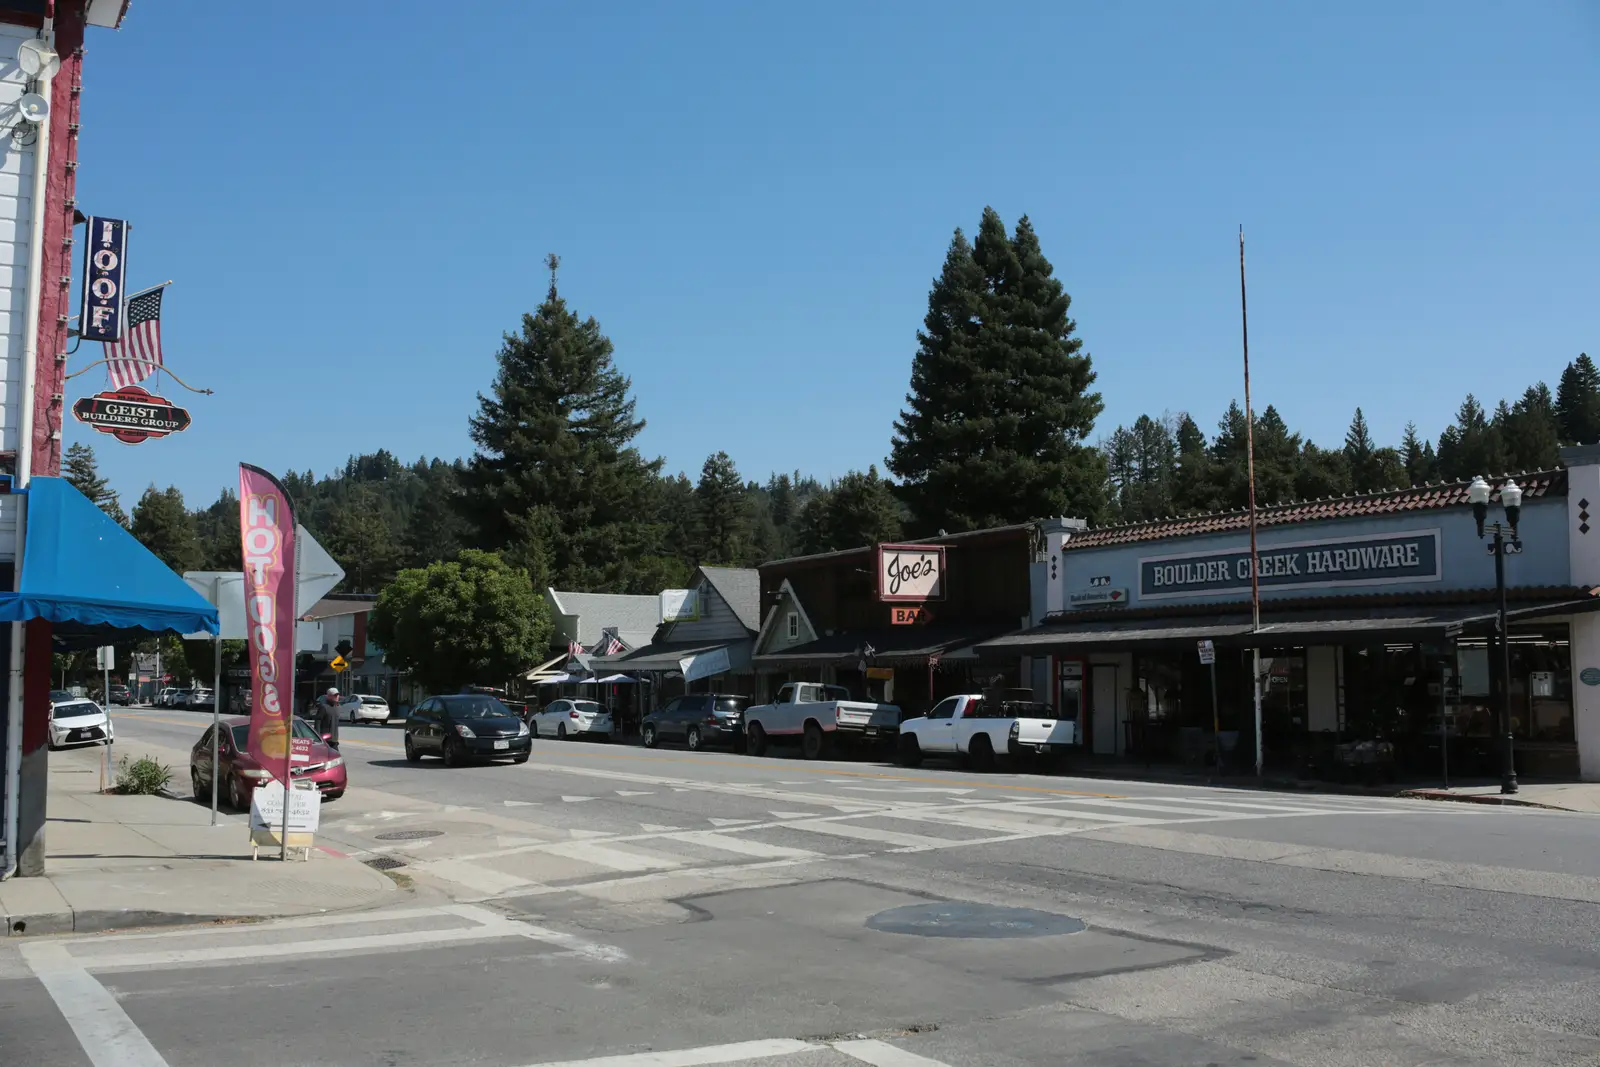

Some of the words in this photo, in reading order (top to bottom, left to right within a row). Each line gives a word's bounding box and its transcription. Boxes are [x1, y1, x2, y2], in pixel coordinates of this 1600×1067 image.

[82, 411, 138, 424] BUILDERS
[140, 418, 179, 428] GROUP
[105, 404, 158, 418] GEIST
[1153, 560, 1231, 586] BOULDER
[1307, 543, 1419, 574] HARDWARE
[888, 553, 936, 594] Joe's
[896, 610, 926, 622] BAR
